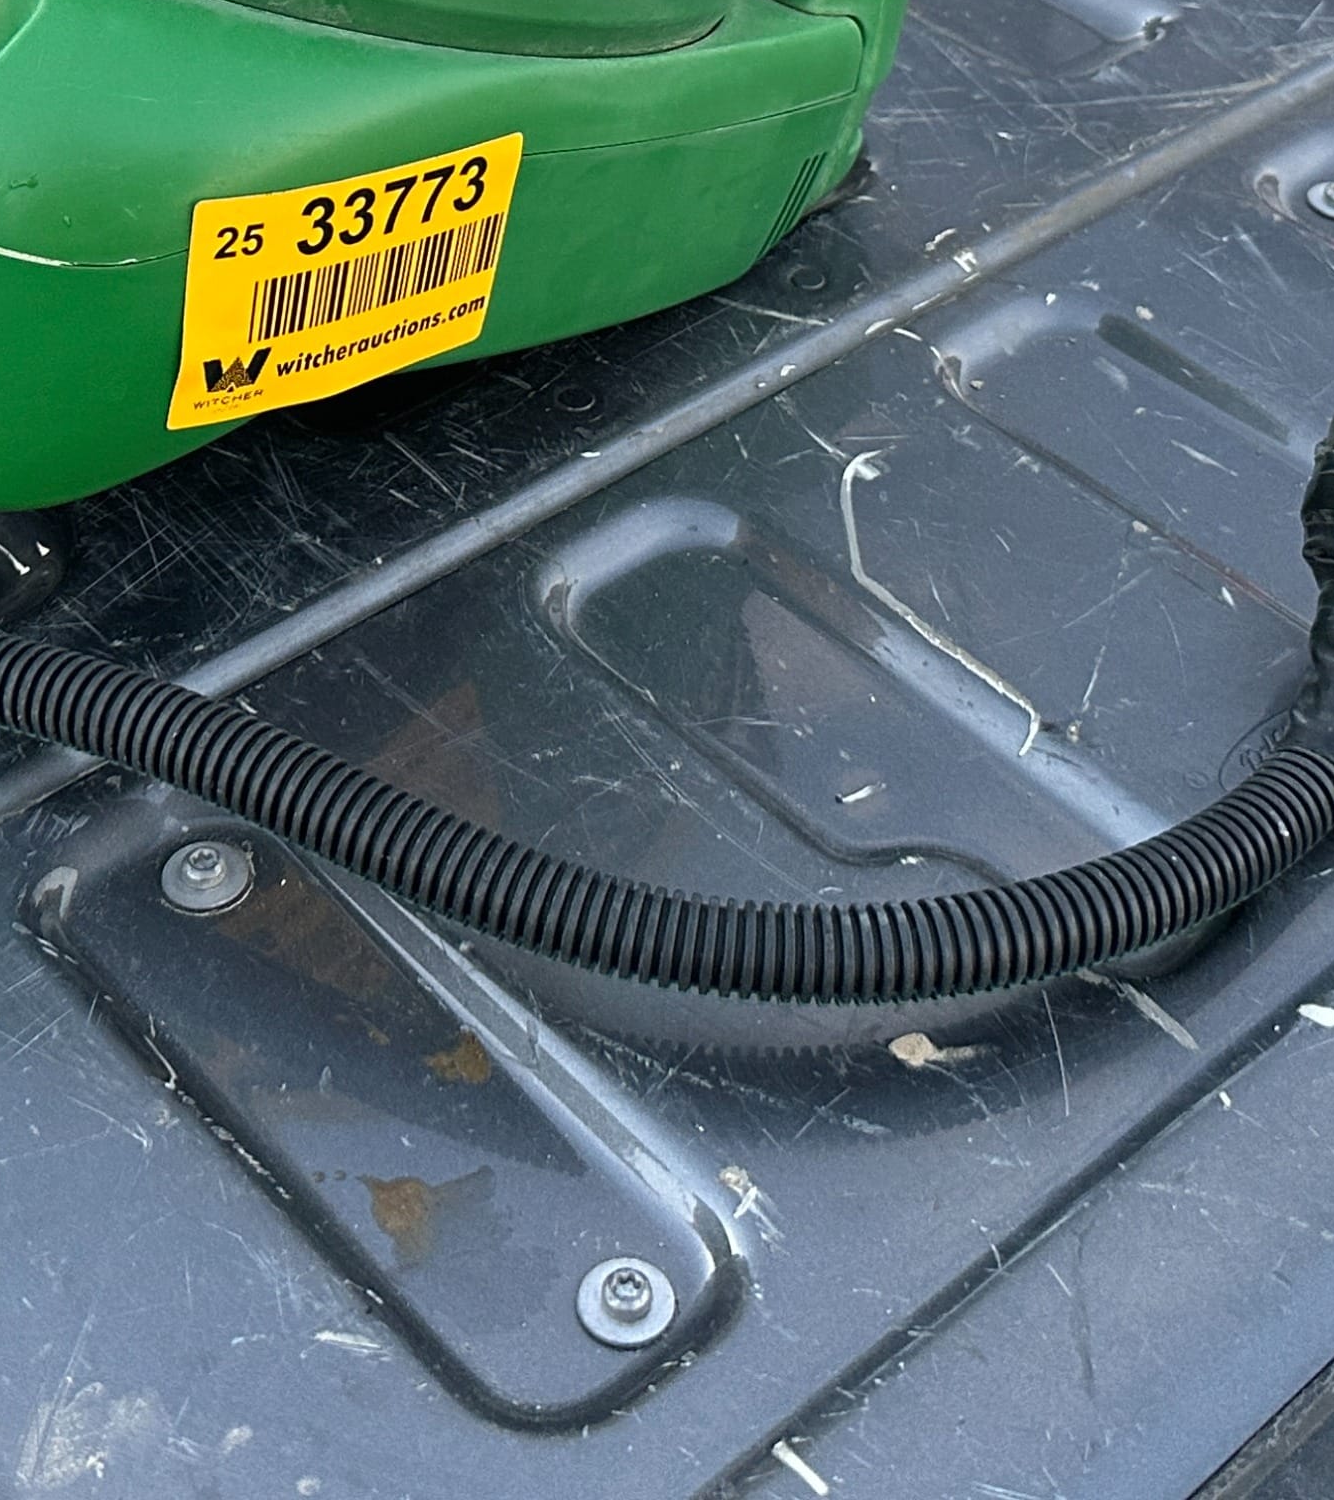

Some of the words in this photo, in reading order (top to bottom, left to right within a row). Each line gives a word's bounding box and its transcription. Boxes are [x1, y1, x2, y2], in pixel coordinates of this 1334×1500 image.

[213, 223, 265, 260] 25
[296, 155, 488, 256] 33773
[275, 295, 486, 378] witcherauctions.com
[192, 388, 265, 411] WITCHER
